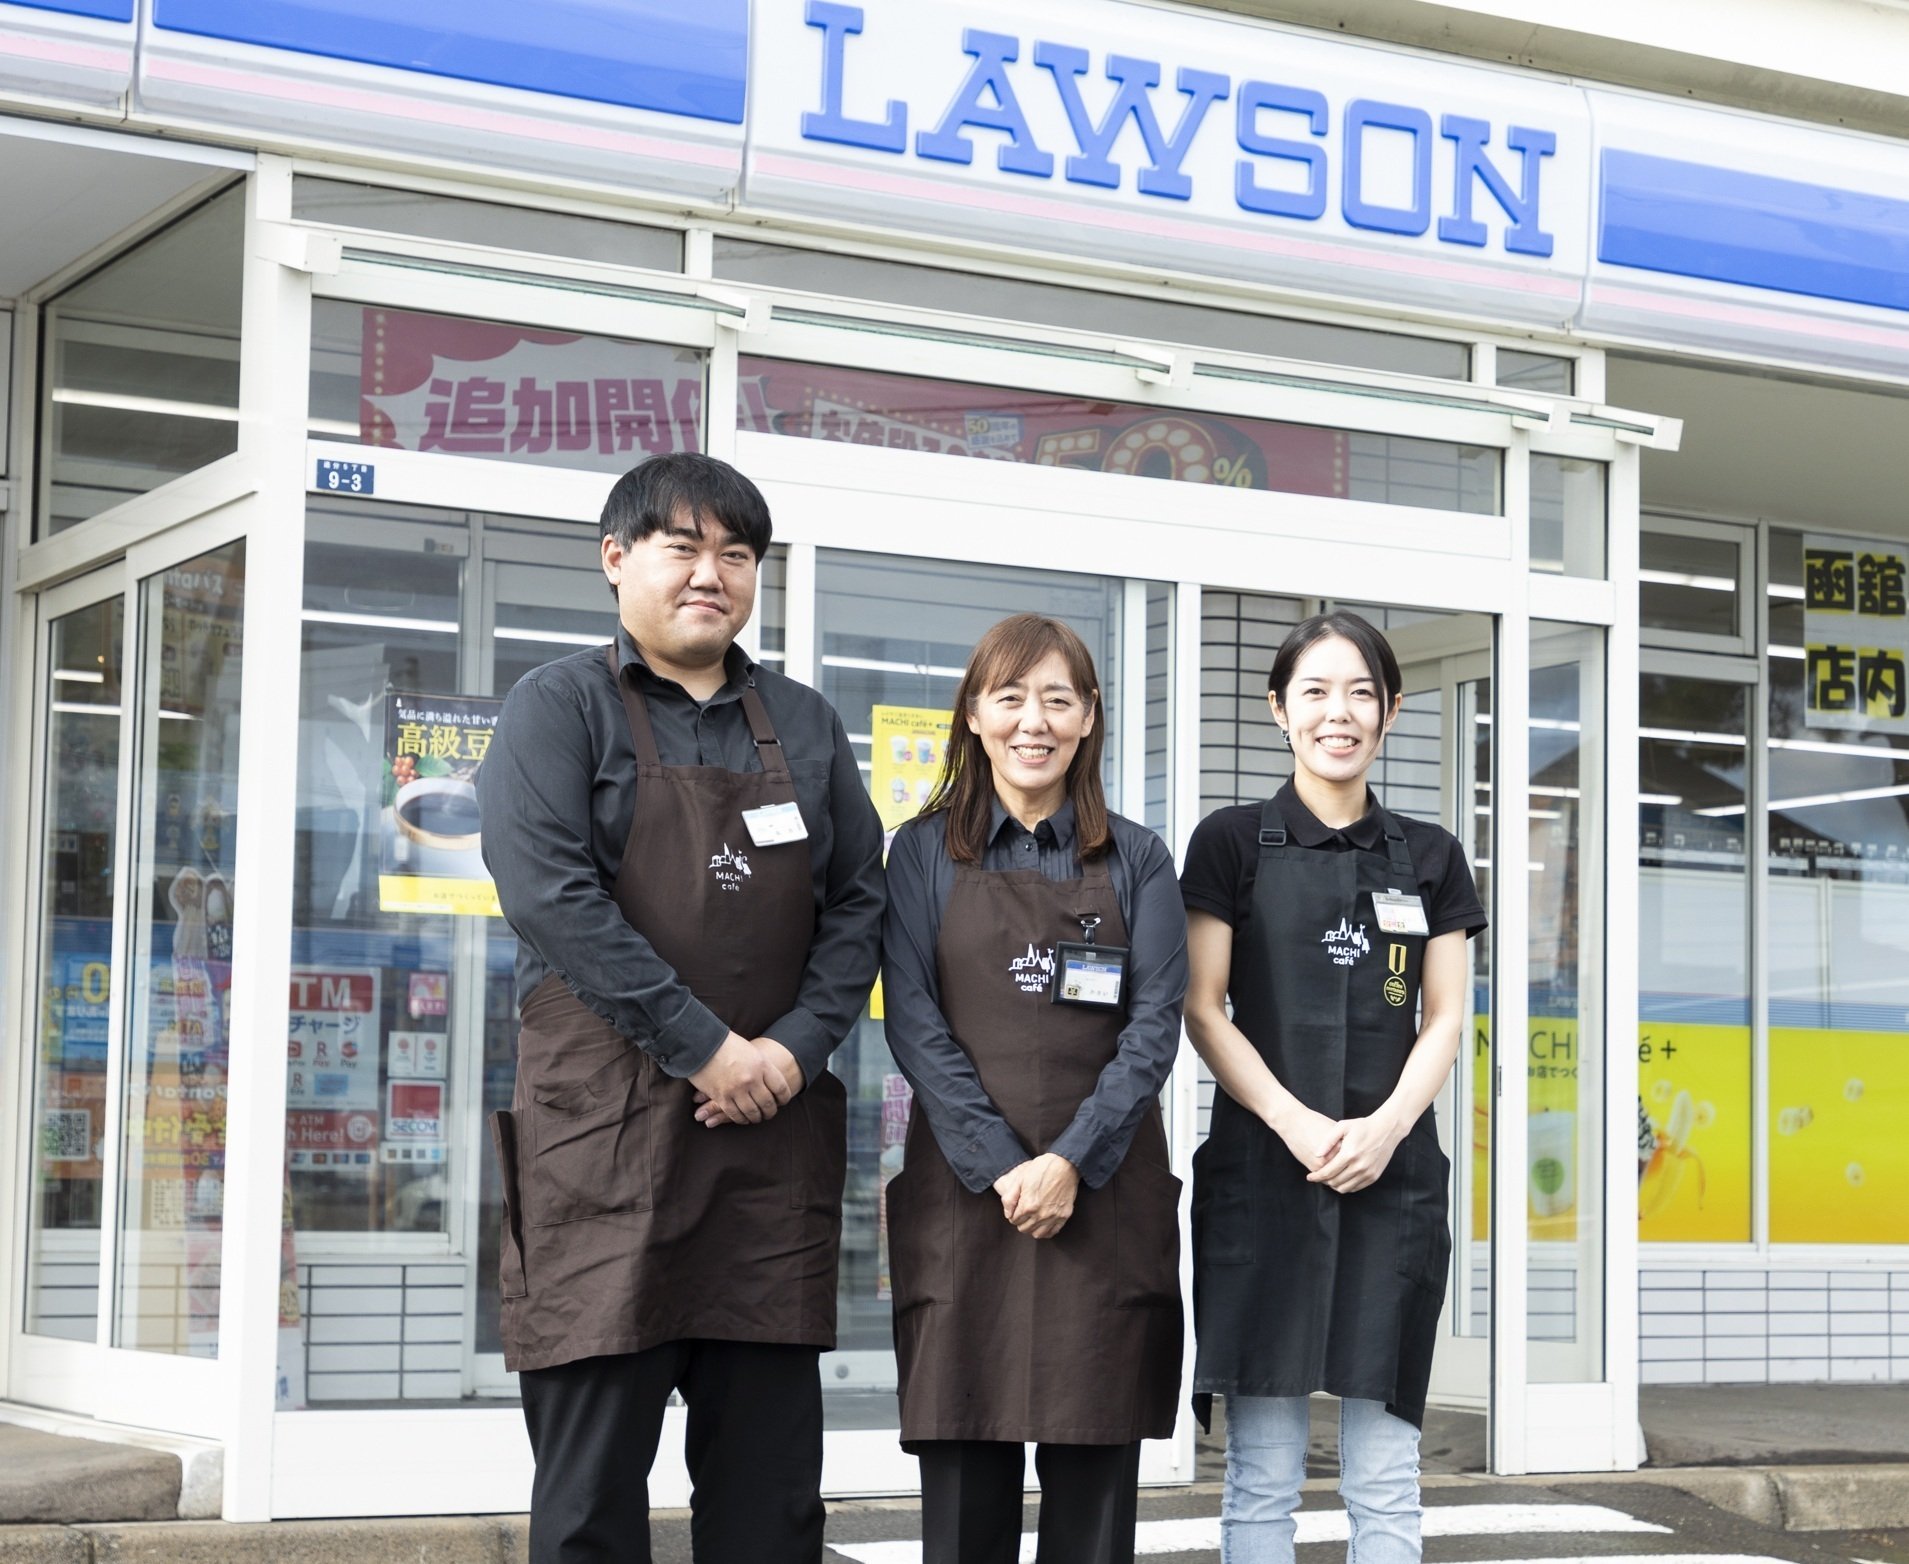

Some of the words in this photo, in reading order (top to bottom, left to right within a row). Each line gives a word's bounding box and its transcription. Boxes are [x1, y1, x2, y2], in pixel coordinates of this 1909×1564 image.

[801, 0, 1557, 258] LAWSON
[328, 471, 362, 492] 9-3
[1805, 549, 1906, 616] 函館
[1806, 645, 1906, 718] 店内
[397, 722, 495, 761] 高級豆
[715, 871, 744, 882] MACHI
[1328, 945, 1361, 958] MACHI
[1015, 972, 1050, 984] MACHI
[1020, 983, 1043, 993] café
[392, 1120, 438, 1132] SECOM
